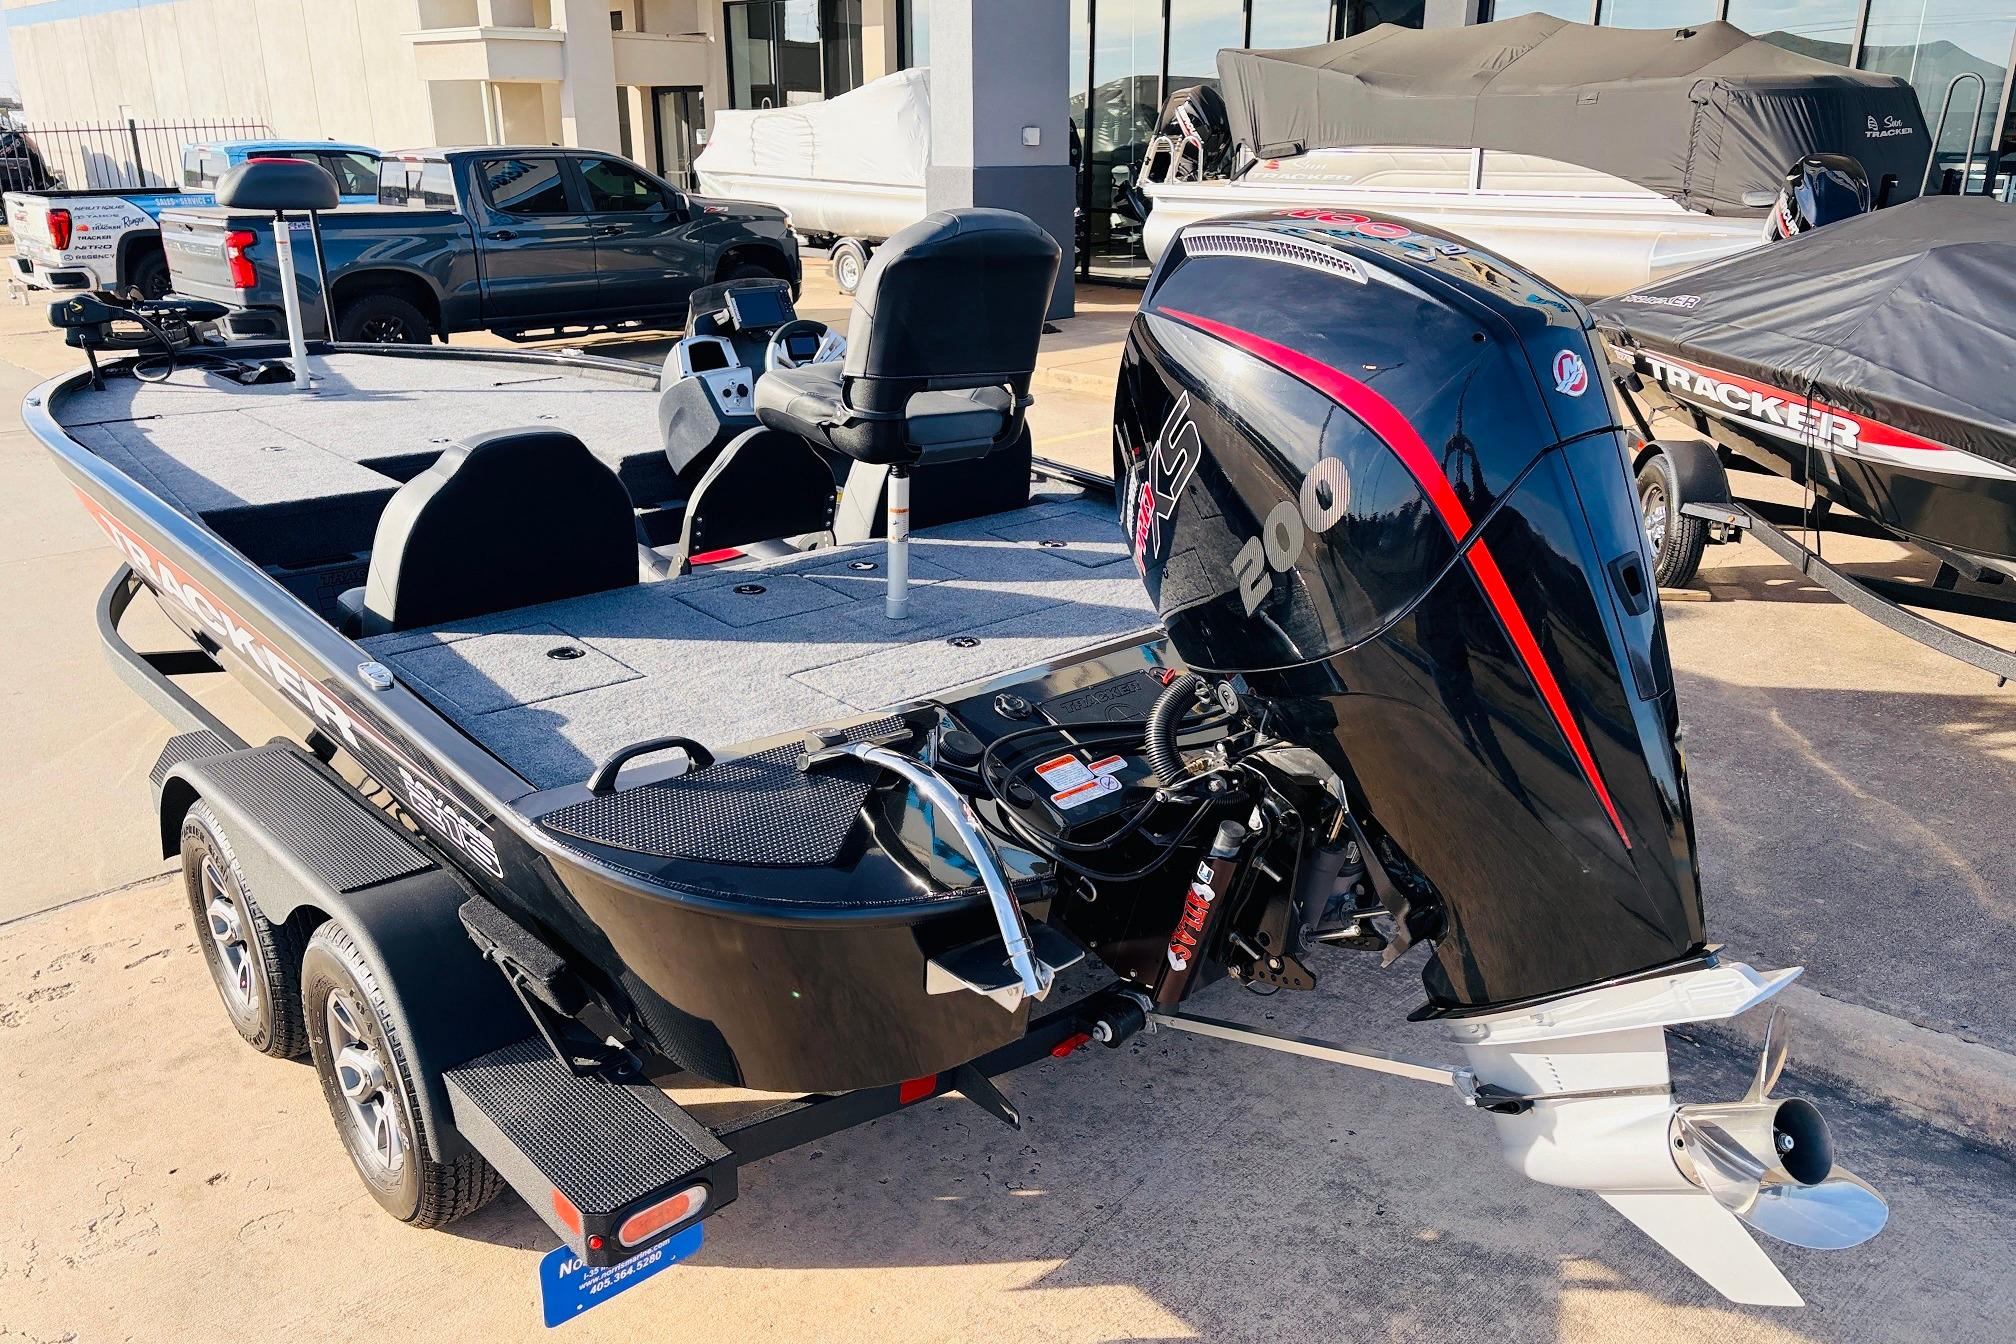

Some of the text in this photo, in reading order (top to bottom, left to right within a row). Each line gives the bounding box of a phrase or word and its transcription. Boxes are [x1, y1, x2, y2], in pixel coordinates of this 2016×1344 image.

[1865, 127, 1913, 138] TRACKER
[1884, 115, 1903, 128] Sun
[1645, 356, 1861, 449] TRACKER
[1149, 389, 1201, 560] XS
[1231, 456, 1352, 619] 200
[98, 511, 362, 751] TRACKER
[1060, 679, 1142, 714] TRACKER
[589, 1250, 662, 1294] 405.364.5280
